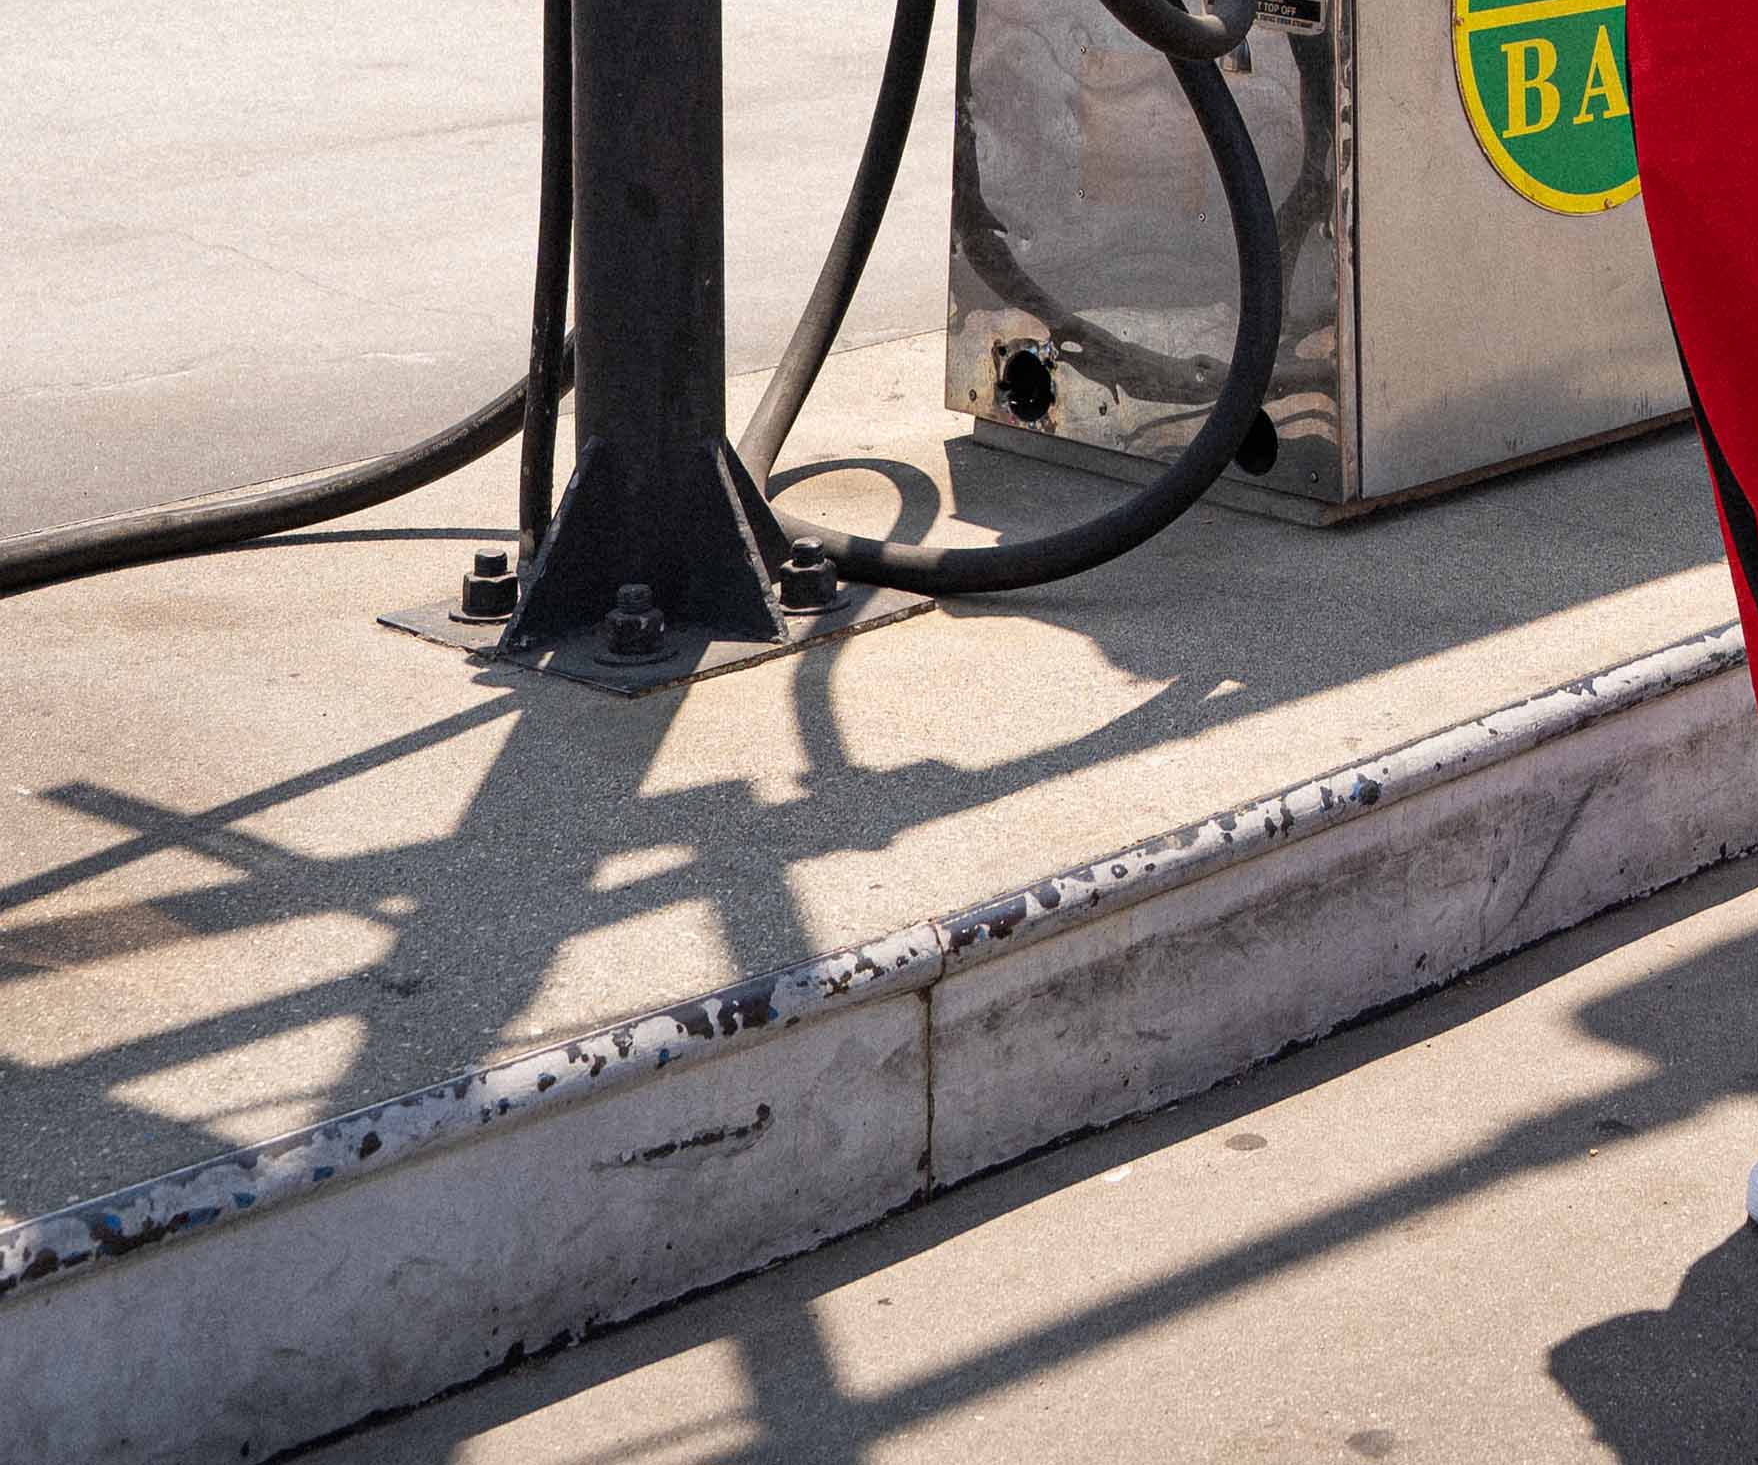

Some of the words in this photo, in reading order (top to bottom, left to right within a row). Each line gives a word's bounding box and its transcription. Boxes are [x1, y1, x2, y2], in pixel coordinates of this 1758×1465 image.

[1263, 2, 1280, 13] TOP
[1280, 5, 1297, 15] OFF
[1501, 24, 1630, 138] BA
